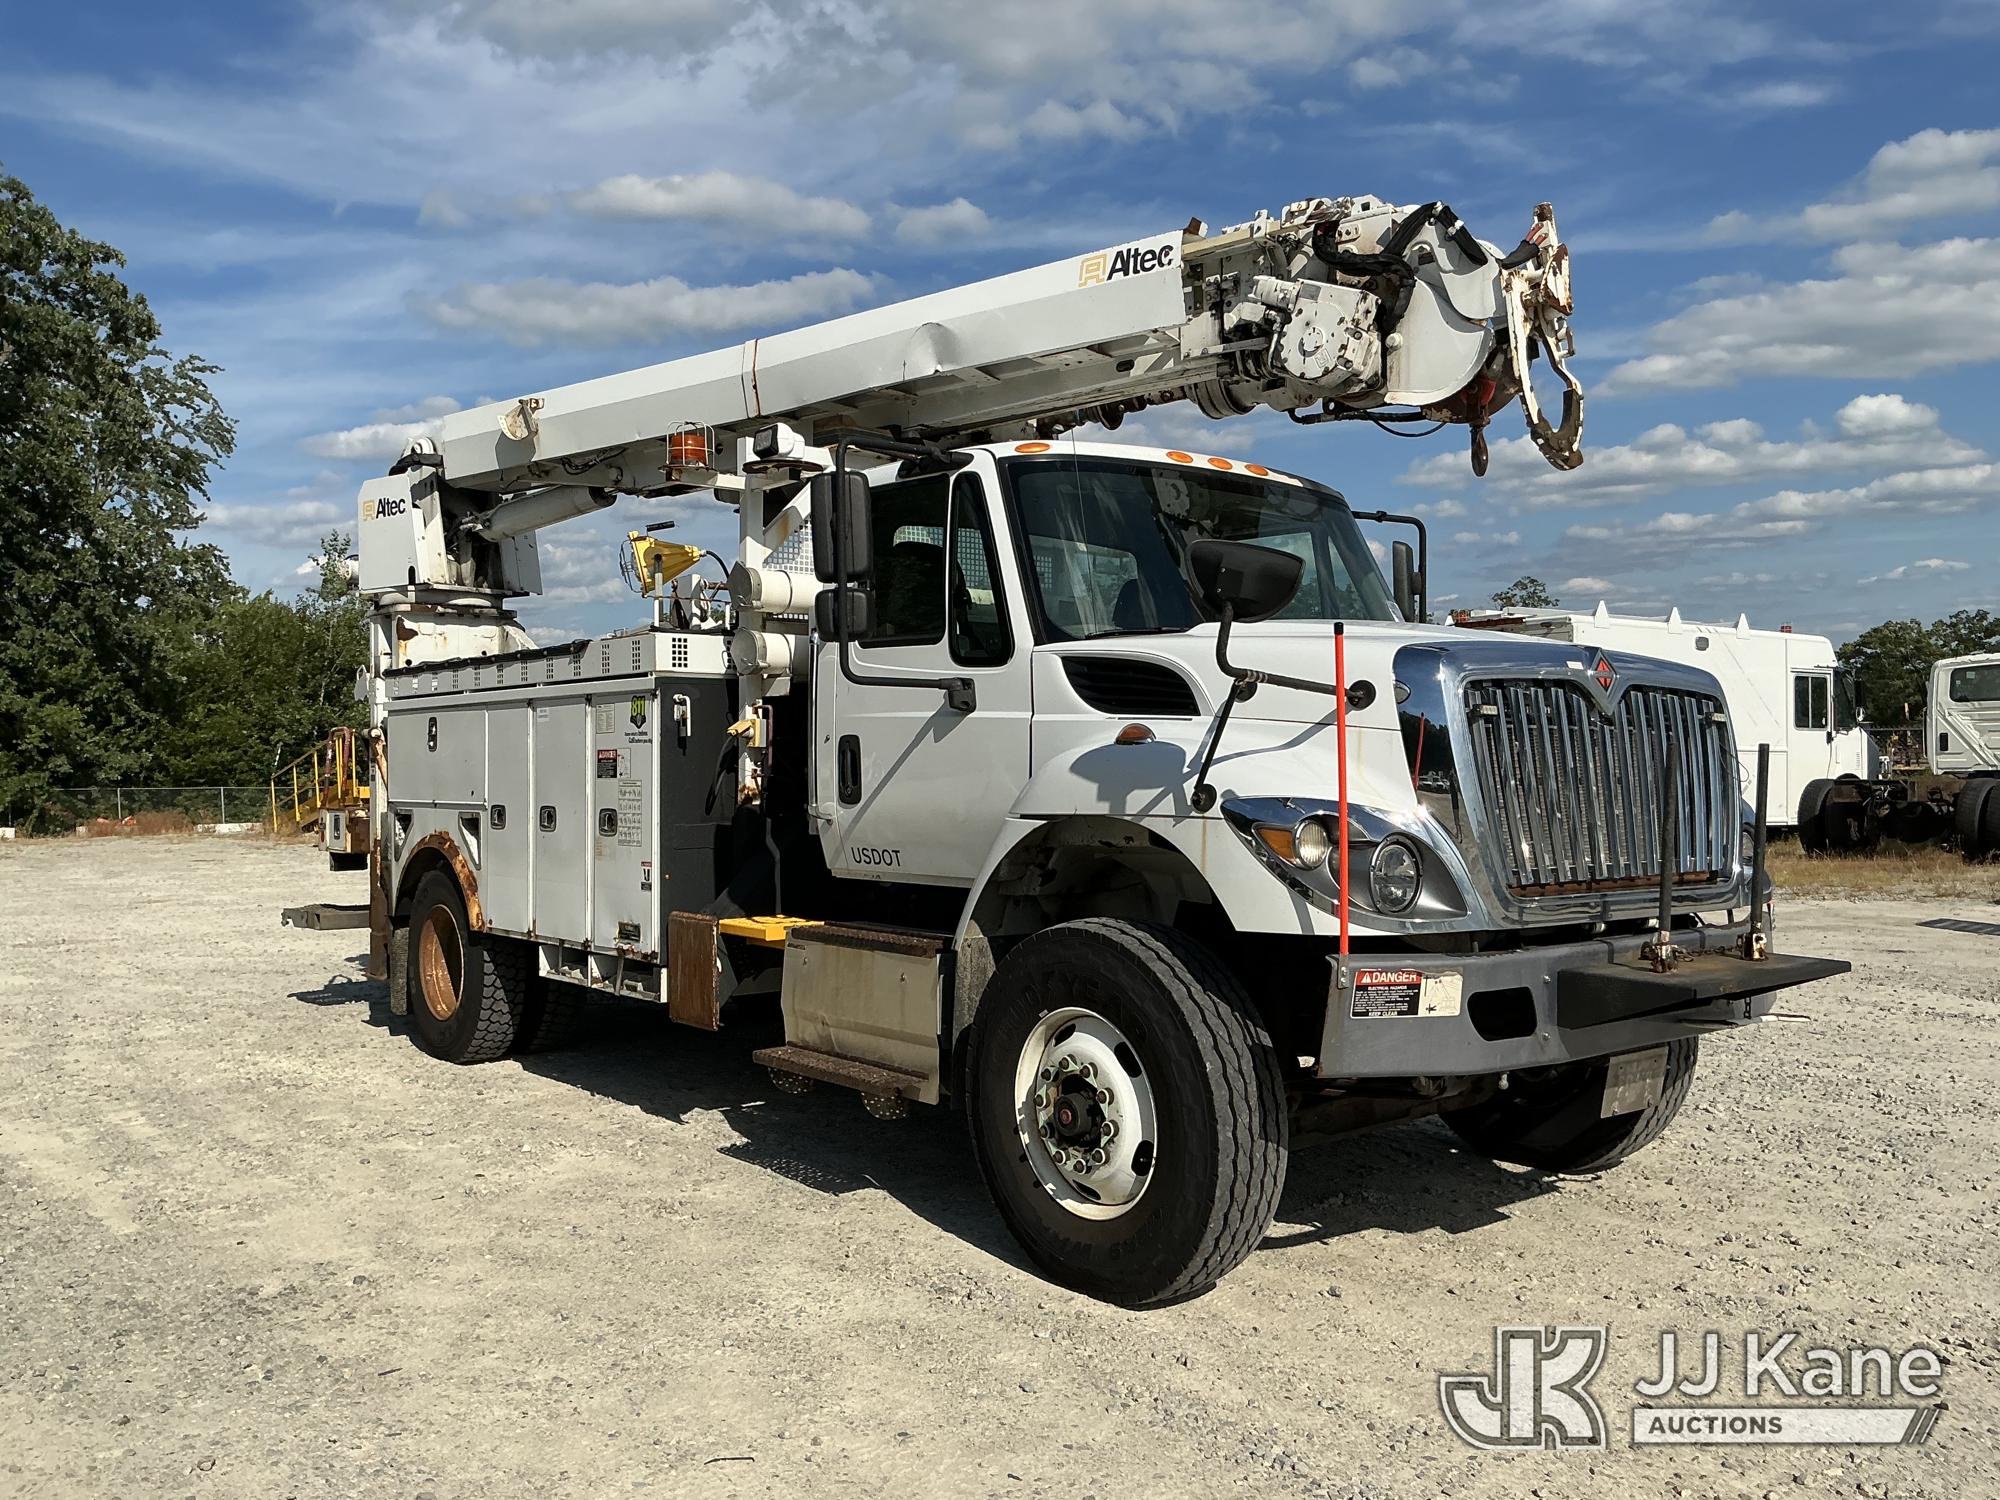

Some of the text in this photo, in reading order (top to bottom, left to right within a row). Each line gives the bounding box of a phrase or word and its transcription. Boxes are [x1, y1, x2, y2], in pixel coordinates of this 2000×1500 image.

[1106, 245, 1174, 281] Altec
[376, 498, 406, 519] Altec
[631, 696, 646, 717] 811
[851, 847, 901, 867] USDOT
[1372, 971, 1417, 983] DANGER
